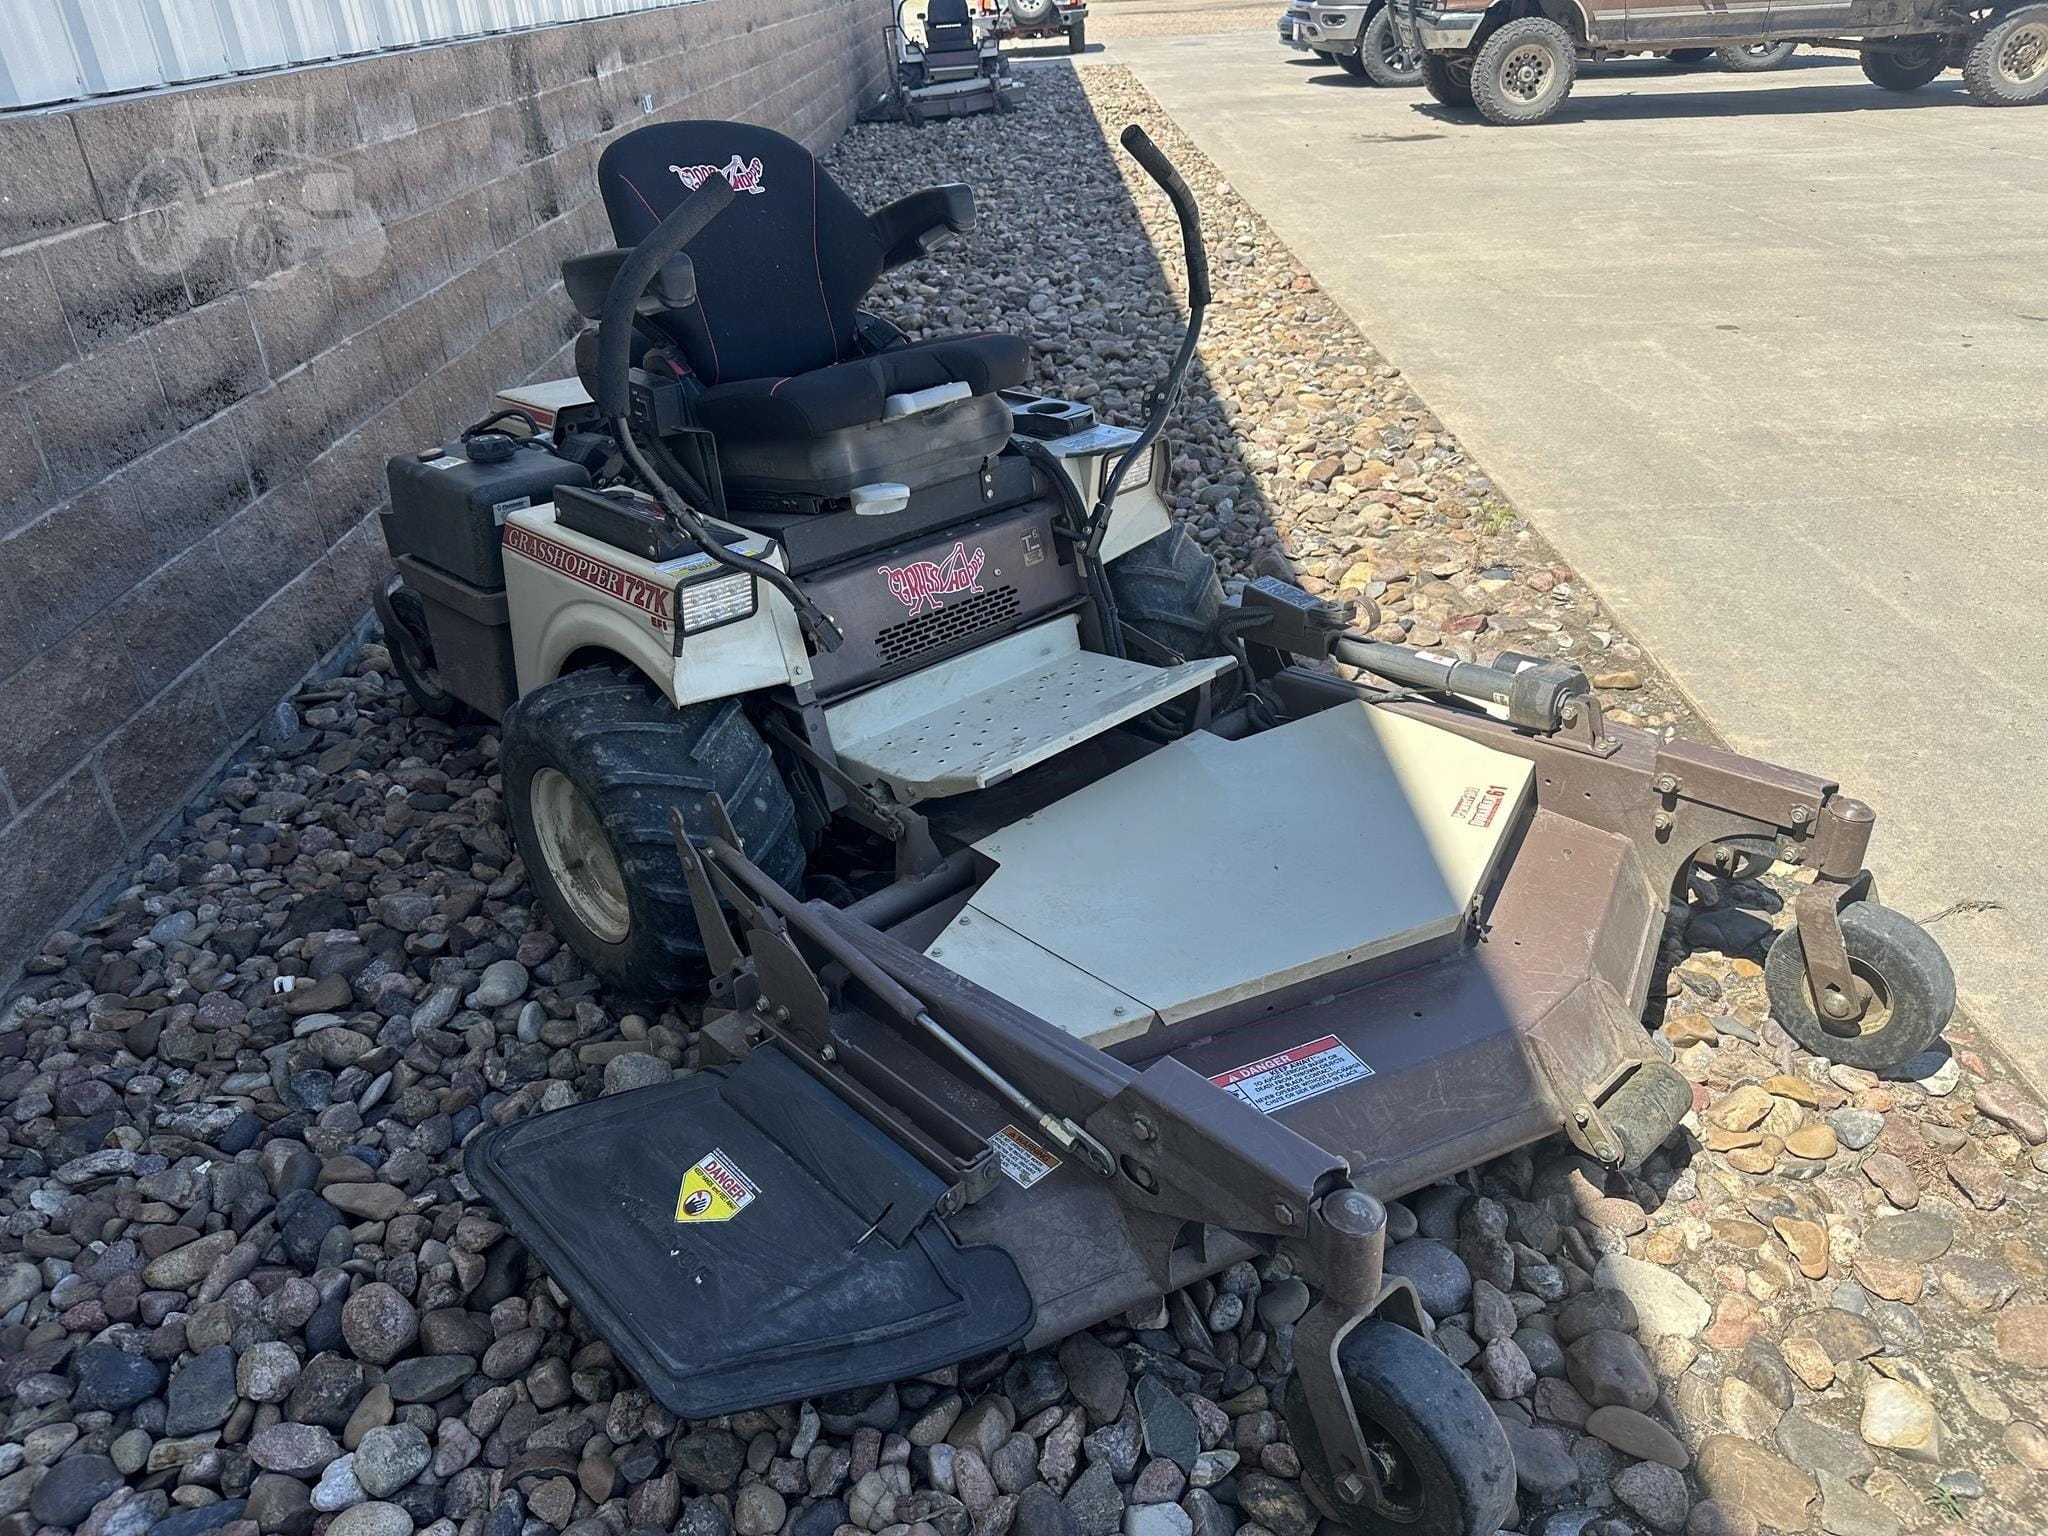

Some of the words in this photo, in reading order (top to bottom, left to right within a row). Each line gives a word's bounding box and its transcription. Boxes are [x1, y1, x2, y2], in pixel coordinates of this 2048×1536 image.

[508, 529, 621, 593] GRASSHOPPER
[623, 575, 670, 618] 727K
[1486, 785, 1508, 797] 61
[1240, 1054, 1292, 1078] DANGER
[1254, 1080, 1264, 1088] TO
[1264, 1073, 1284, 1084] AVOID
[1328, 1053, 1338, 1061] OR
[1254, 1082, 1275, 1093] DEATH
[1275, 1075, 1293, 1085] FROM
[1293, 1066, 1320, 1078] THROWN
[1320, 1057, 1345, 1069] OBJECTS
[1269, 1065, 1289, 1076] KEEP
[1255, 1093, 1275, 1104] NEVER
[1275, 1084, 1300, 1098] OPERATE
[1301, 1074, 1328, 1087] WITHOUT
[1328, 1062, 1362, 1078] DISCHARGE
[1265, 1095, 1285, 1107] CHUTE
[1285, 1090, 1295, 1099] OR
[1295, 1086, 1309, 1096] SIDE
[1309, 1078, 1332, 1091] SHIELDS
[1274, 1084, 1285, 1092] OR
[1285, 1077, 1304, 1088] BLADE
[1016, 1135, 1051, 1162] WARNING
[694, 1167, 704, 1177] KEEP
[701, 1174, 715, 1188] HANDS
[718, 1191, 729, 1202] FEET
[704, 1160, 746, 1201] DANGER
